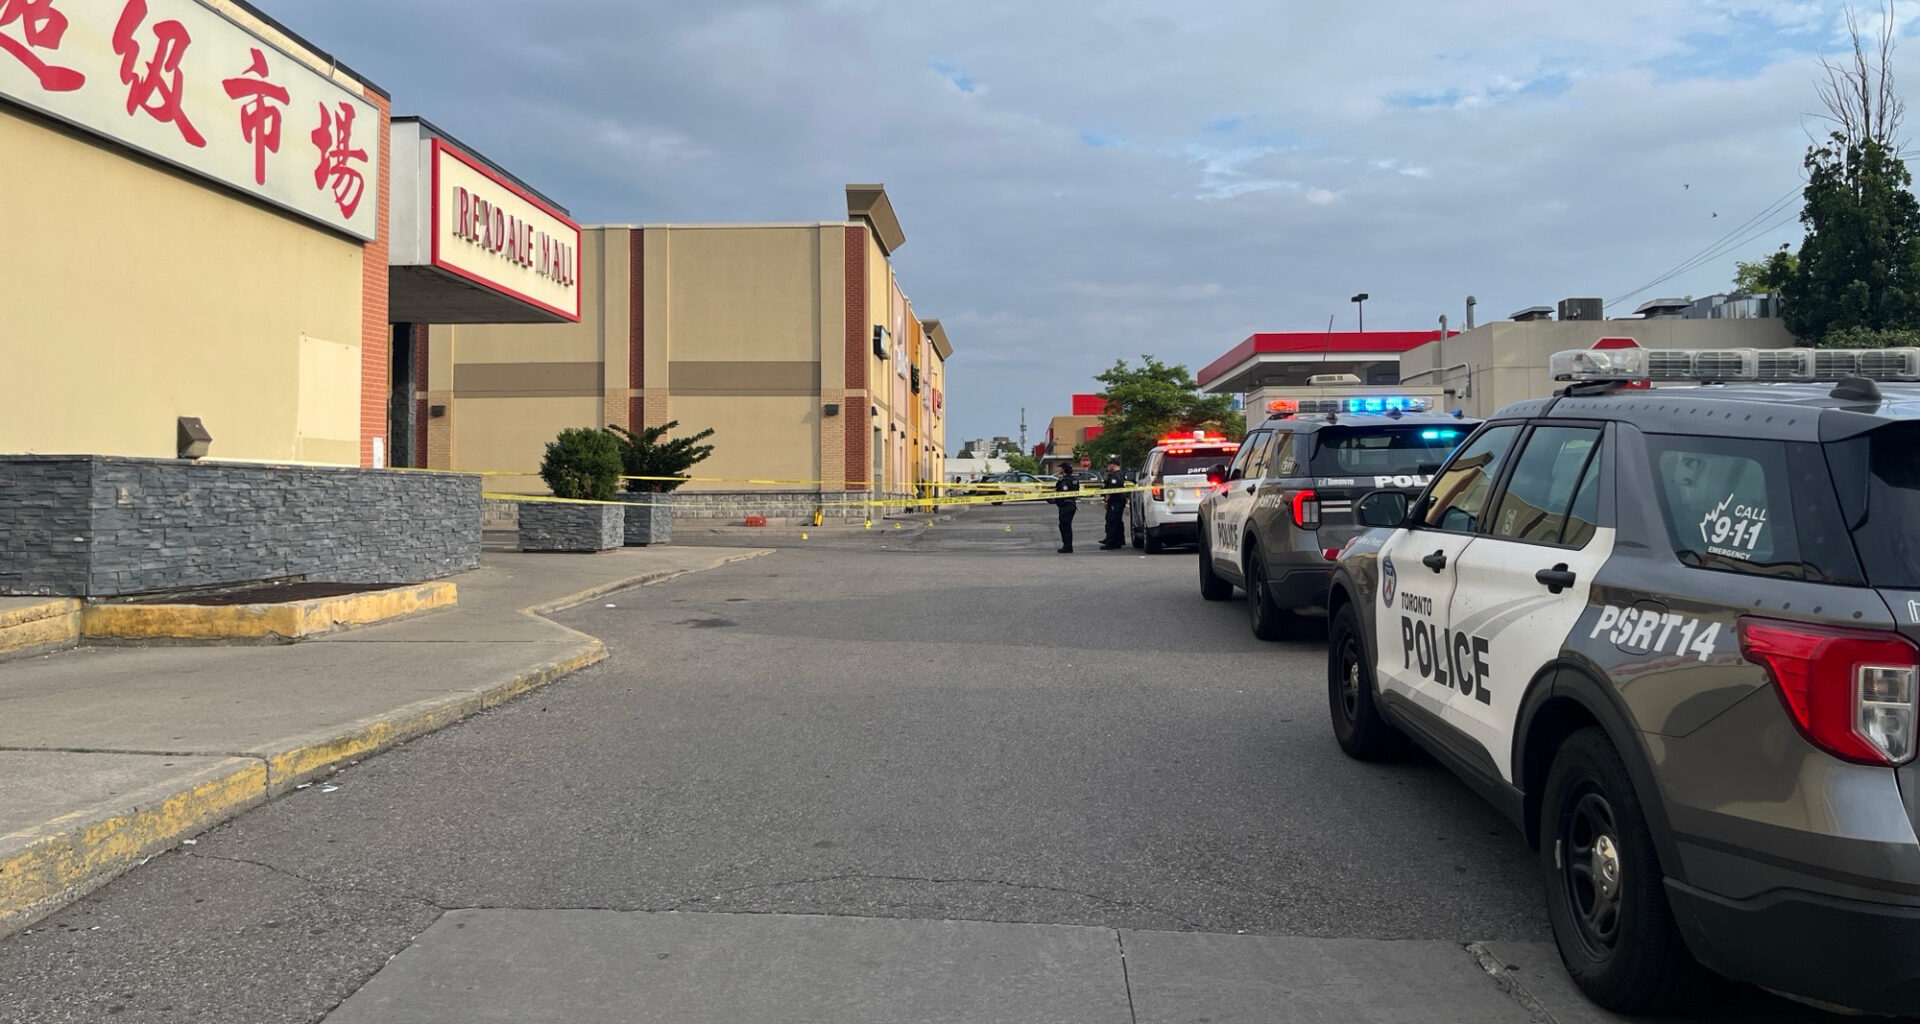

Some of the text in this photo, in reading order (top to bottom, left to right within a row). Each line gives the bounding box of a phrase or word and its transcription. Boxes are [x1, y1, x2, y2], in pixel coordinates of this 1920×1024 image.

[453, 186, 574, 287] REXDALE MALL
[1374, 474, 1435, 489] POLI
[1734, 504, 1766, 521] CALL
[1711, 516, 1763, 550] 9-1-1
[1708, 546, 1751, 560] EMERGENCY
[1401, 592, 1432, 617] TORONTO
[1589, 604, 1722, 662] PSRT14
[1401, 616, 1491, 706] POLICE
